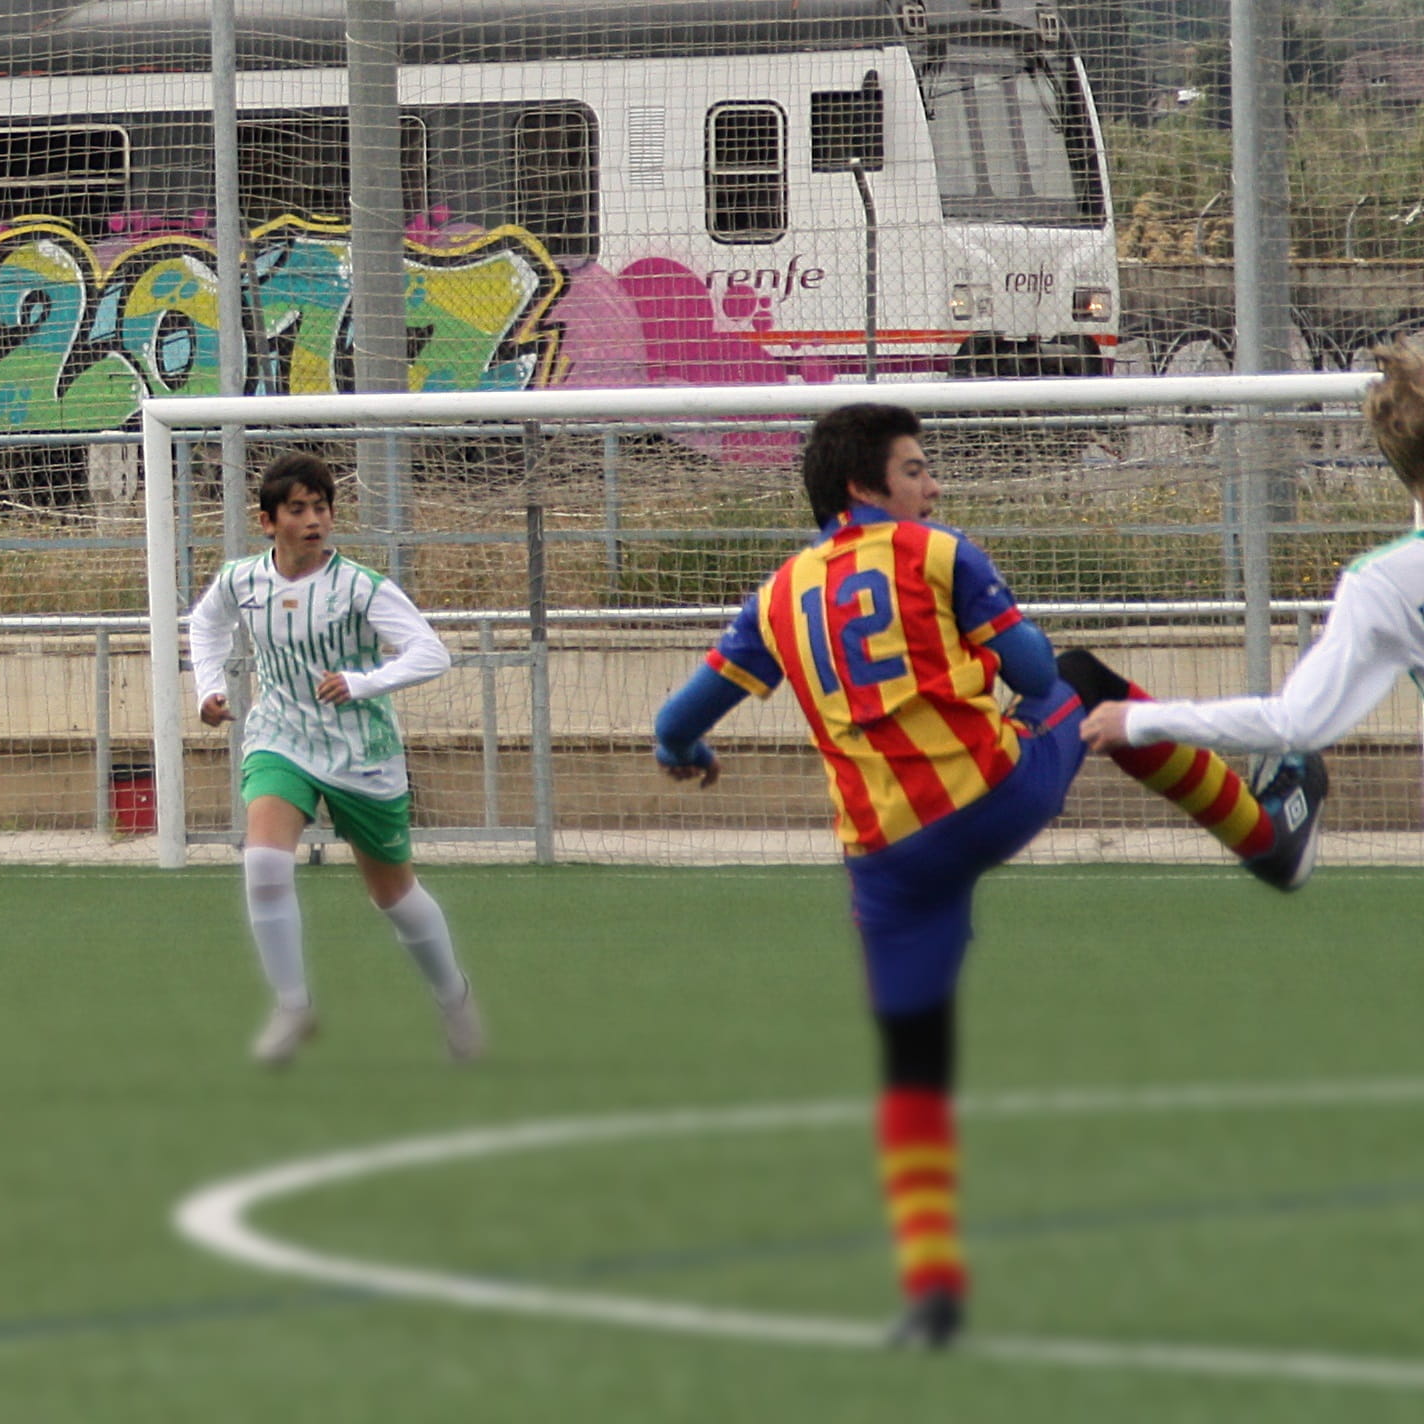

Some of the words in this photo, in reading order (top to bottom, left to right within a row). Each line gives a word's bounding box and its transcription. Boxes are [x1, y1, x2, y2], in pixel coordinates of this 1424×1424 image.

[705, 253, 825, 304] renfe
[1004, 261, 1054, 307] renfe
[800, 567, 909, 696] 12
